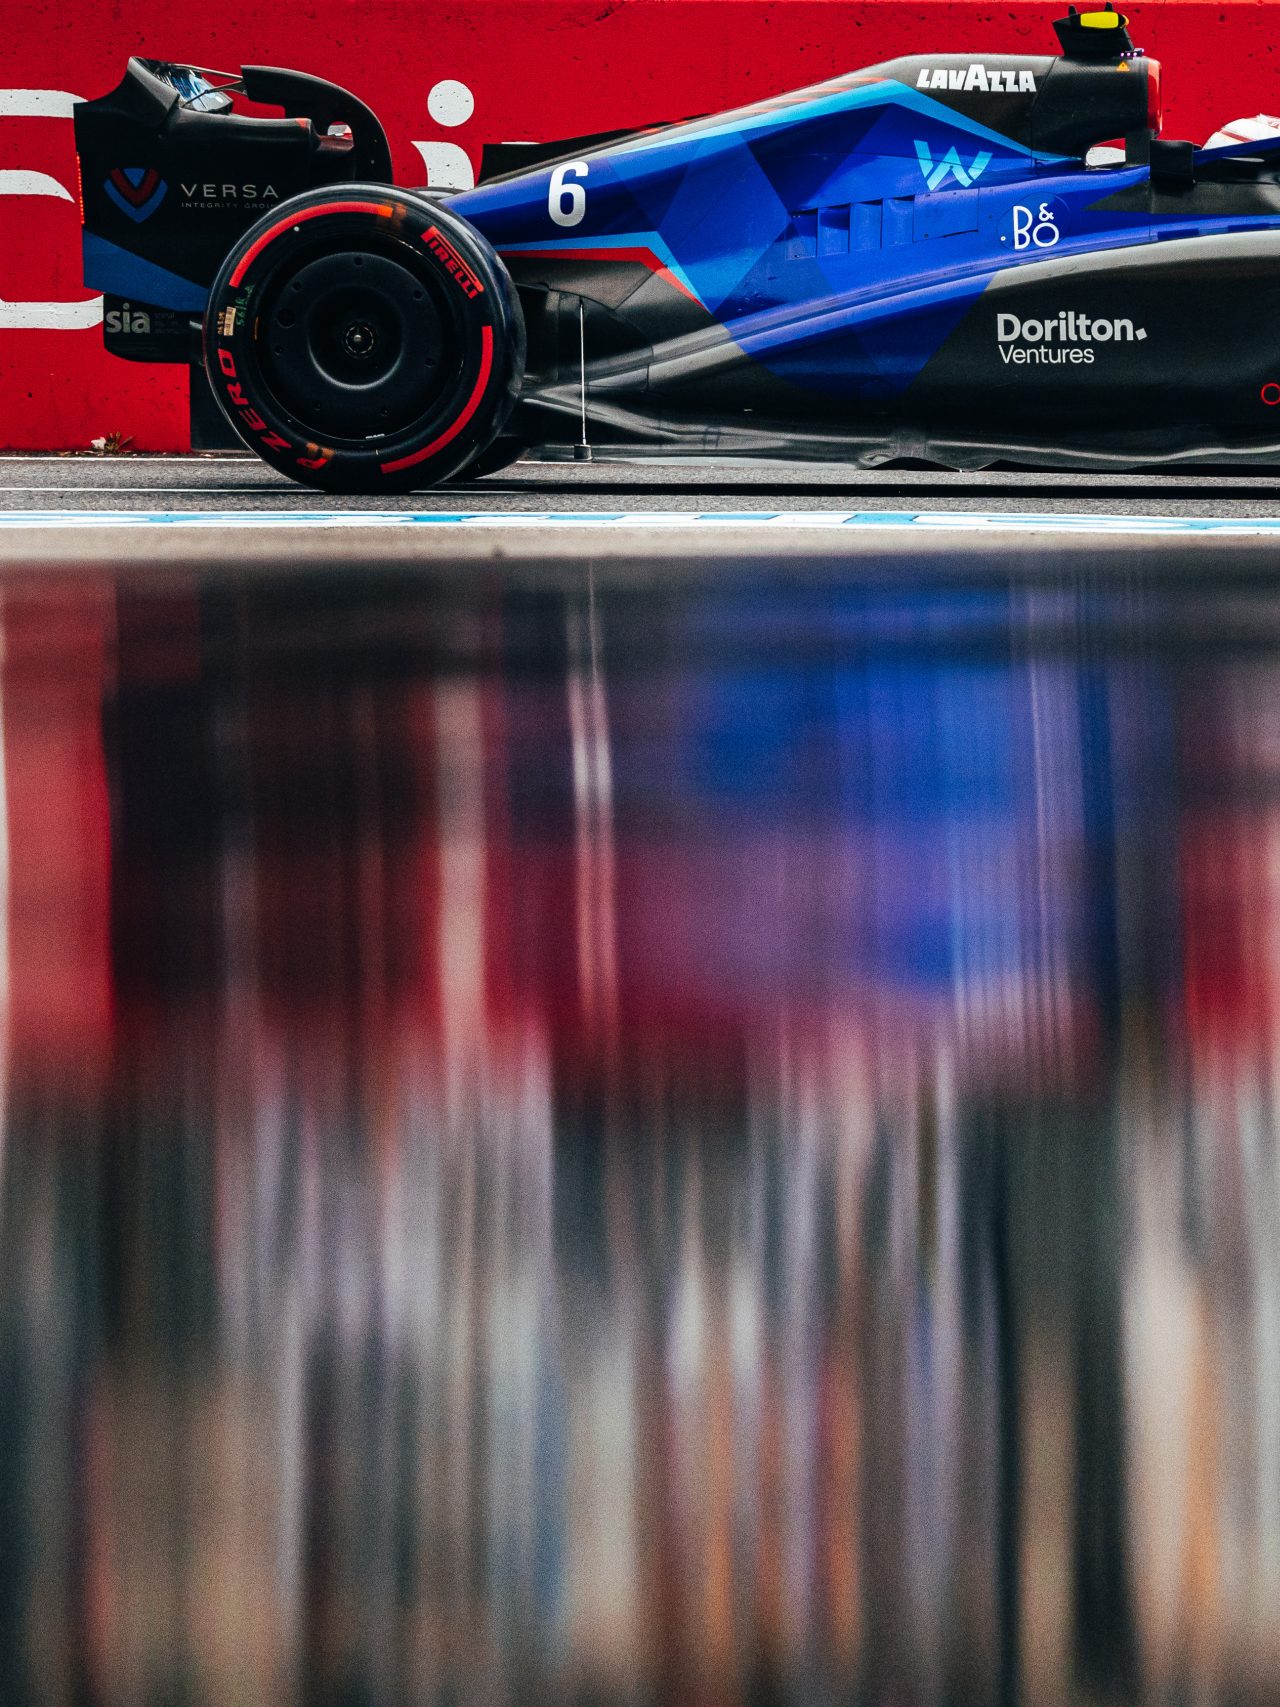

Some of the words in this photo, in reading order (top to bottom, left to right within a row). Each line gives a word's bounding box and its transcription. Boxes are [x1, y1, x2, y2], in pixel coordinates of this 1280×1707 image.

[916, 64, 1037, 92] LAVAZZA
[180, 183, 279, 198] VERSA
[548, 161, 588, 226] 6
[420, 225, 484, 299] PIRELLI
[105, 302, 150, 334] sia
[998, 344, 1095, 364] Ventures
[217, 348, 292, 453] ZERO
